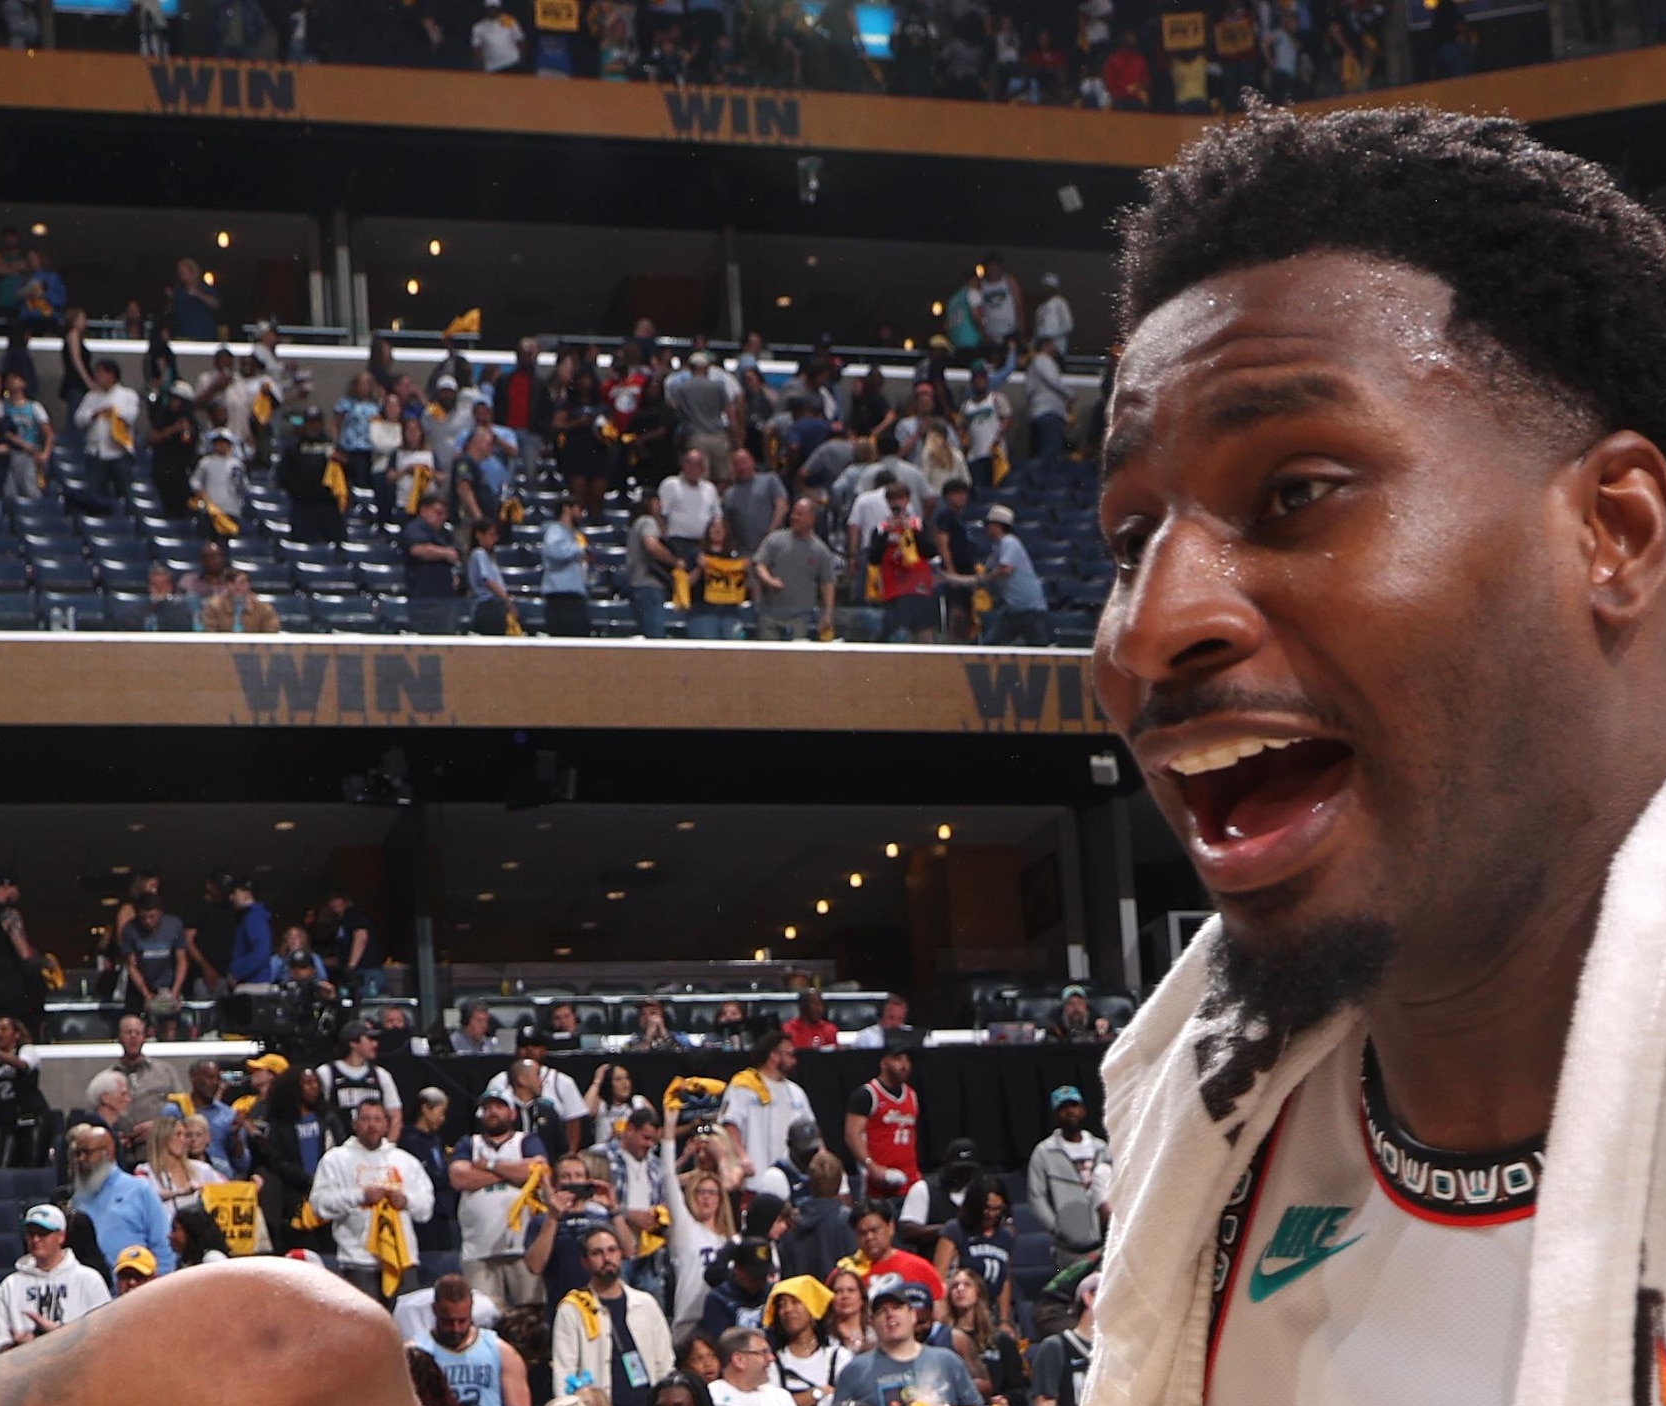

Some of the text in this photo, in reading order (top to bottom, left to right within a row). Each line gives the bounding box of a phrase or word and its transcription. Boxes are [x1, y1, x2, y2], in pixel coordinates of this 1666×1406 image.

[150, 64, 297, 110] WIN
[664, 93, 801, 138] WIN
[232, 652, 444, 714] WIN
[965, 662, 1111, 722] WI
[1263, 1205, 1354, 1259] NIKE
